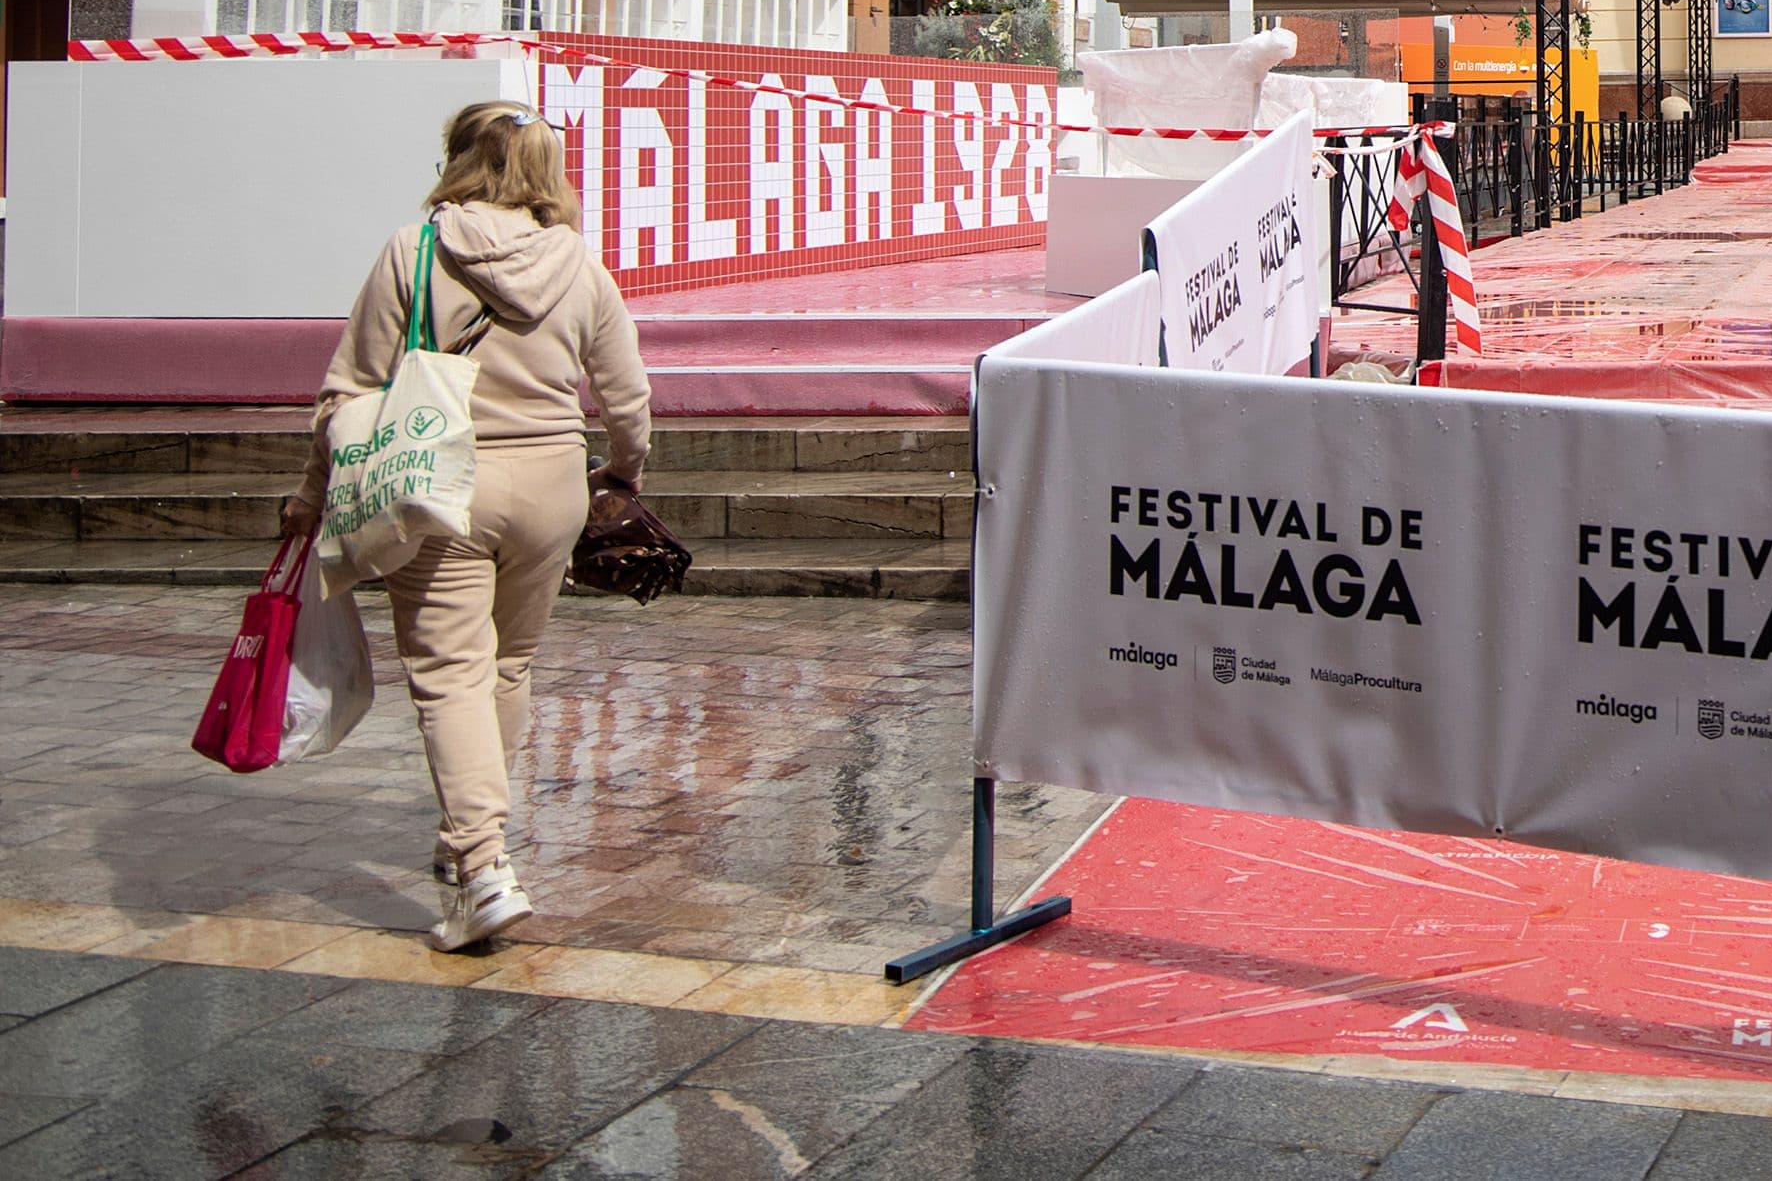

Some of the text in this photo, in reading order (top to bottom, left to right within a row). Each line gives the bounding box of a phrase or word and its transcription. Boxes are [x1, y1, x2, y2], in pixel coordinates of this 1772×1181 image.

[545, 65, 892, 270] MÁLAGA
[1185, 240, 1239, 307] FESTIVAL DE
[1111, 486, 1422, 550] FESTIVAL DE
[1110, 532, 1421, 625] MÁLAGA
[1241, 657, 1276, 671] Ciudad
[1242, 671, 1291, 686] de Málaga
[1311, 669, 1422, 693] MálagaProcultura
[1731, 711, 1770, 725] Ciudad
[1731, 726, 1744, 736] de
[1423, 1033, 1518, 1043] Andalucía
